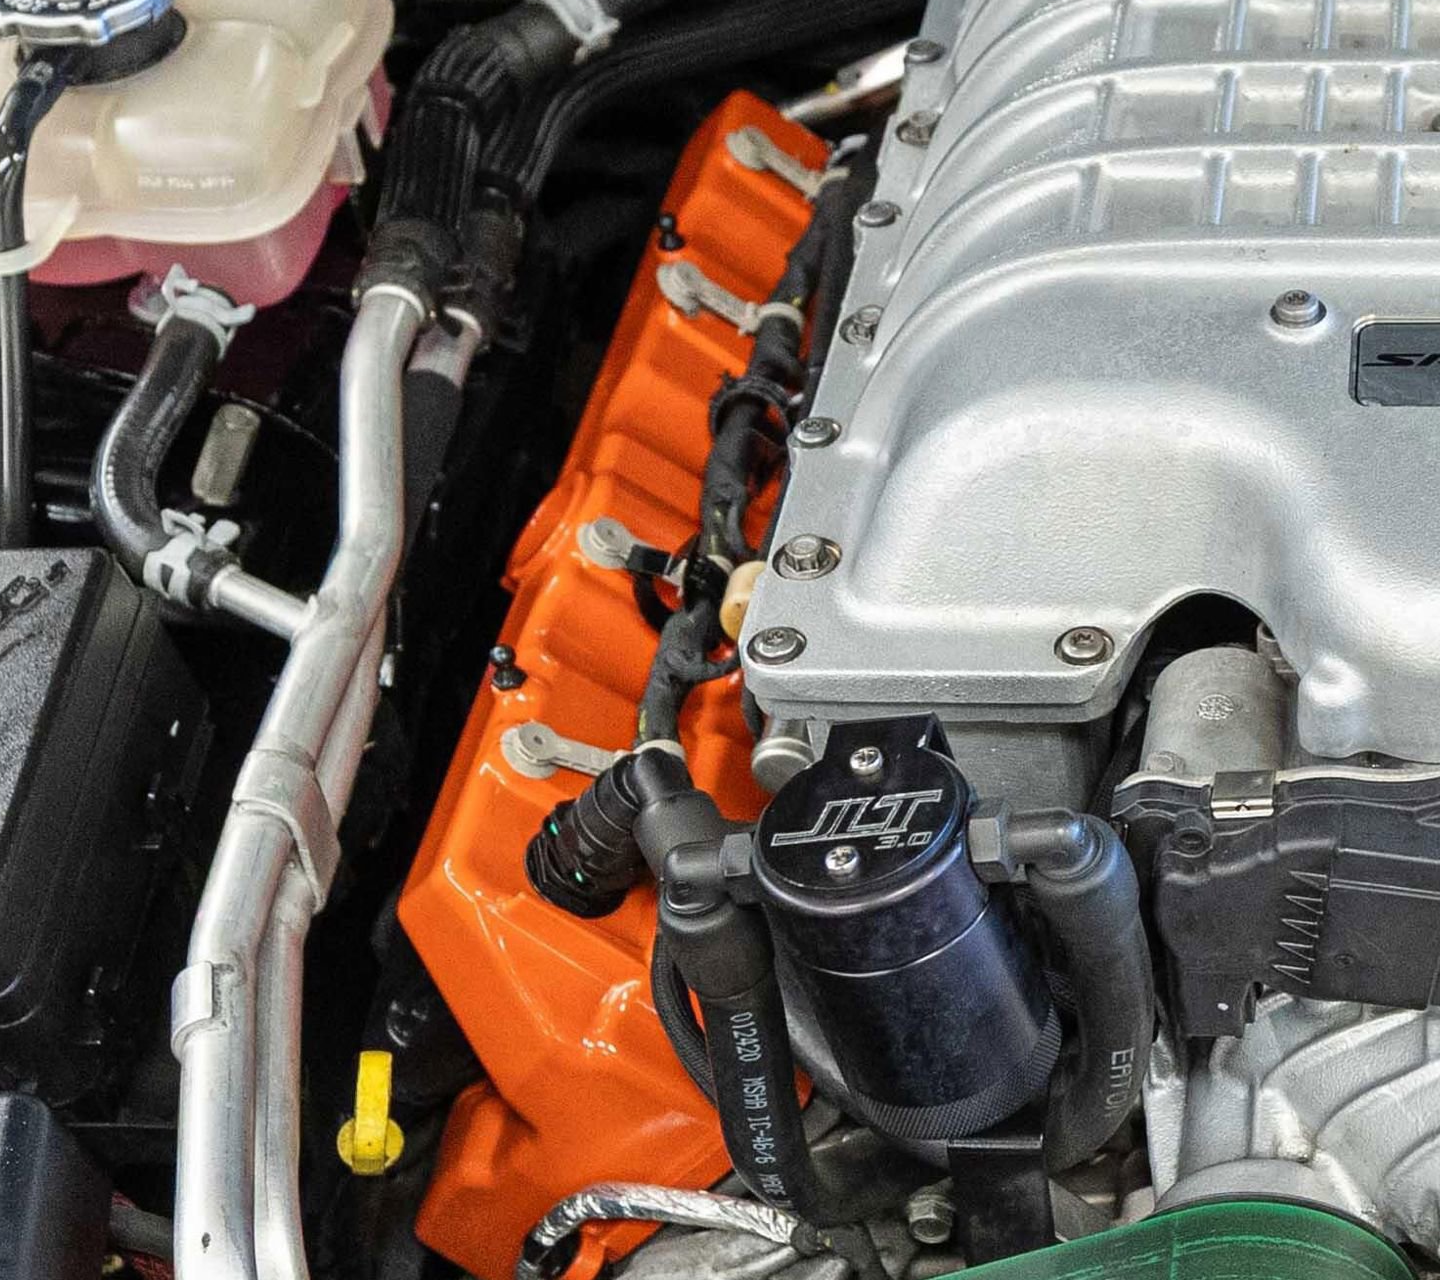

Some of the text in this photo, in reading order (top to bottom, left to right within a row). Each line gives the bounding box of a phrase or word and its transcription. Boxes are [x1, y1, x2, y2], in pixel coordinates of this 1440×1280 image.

[770, 788, 944, 847] JLT
[874, 831, 934, 851] 3.0
[729, 1011, 762, 1063] 012420
[742, 1076, 768, 1110] MSHA
